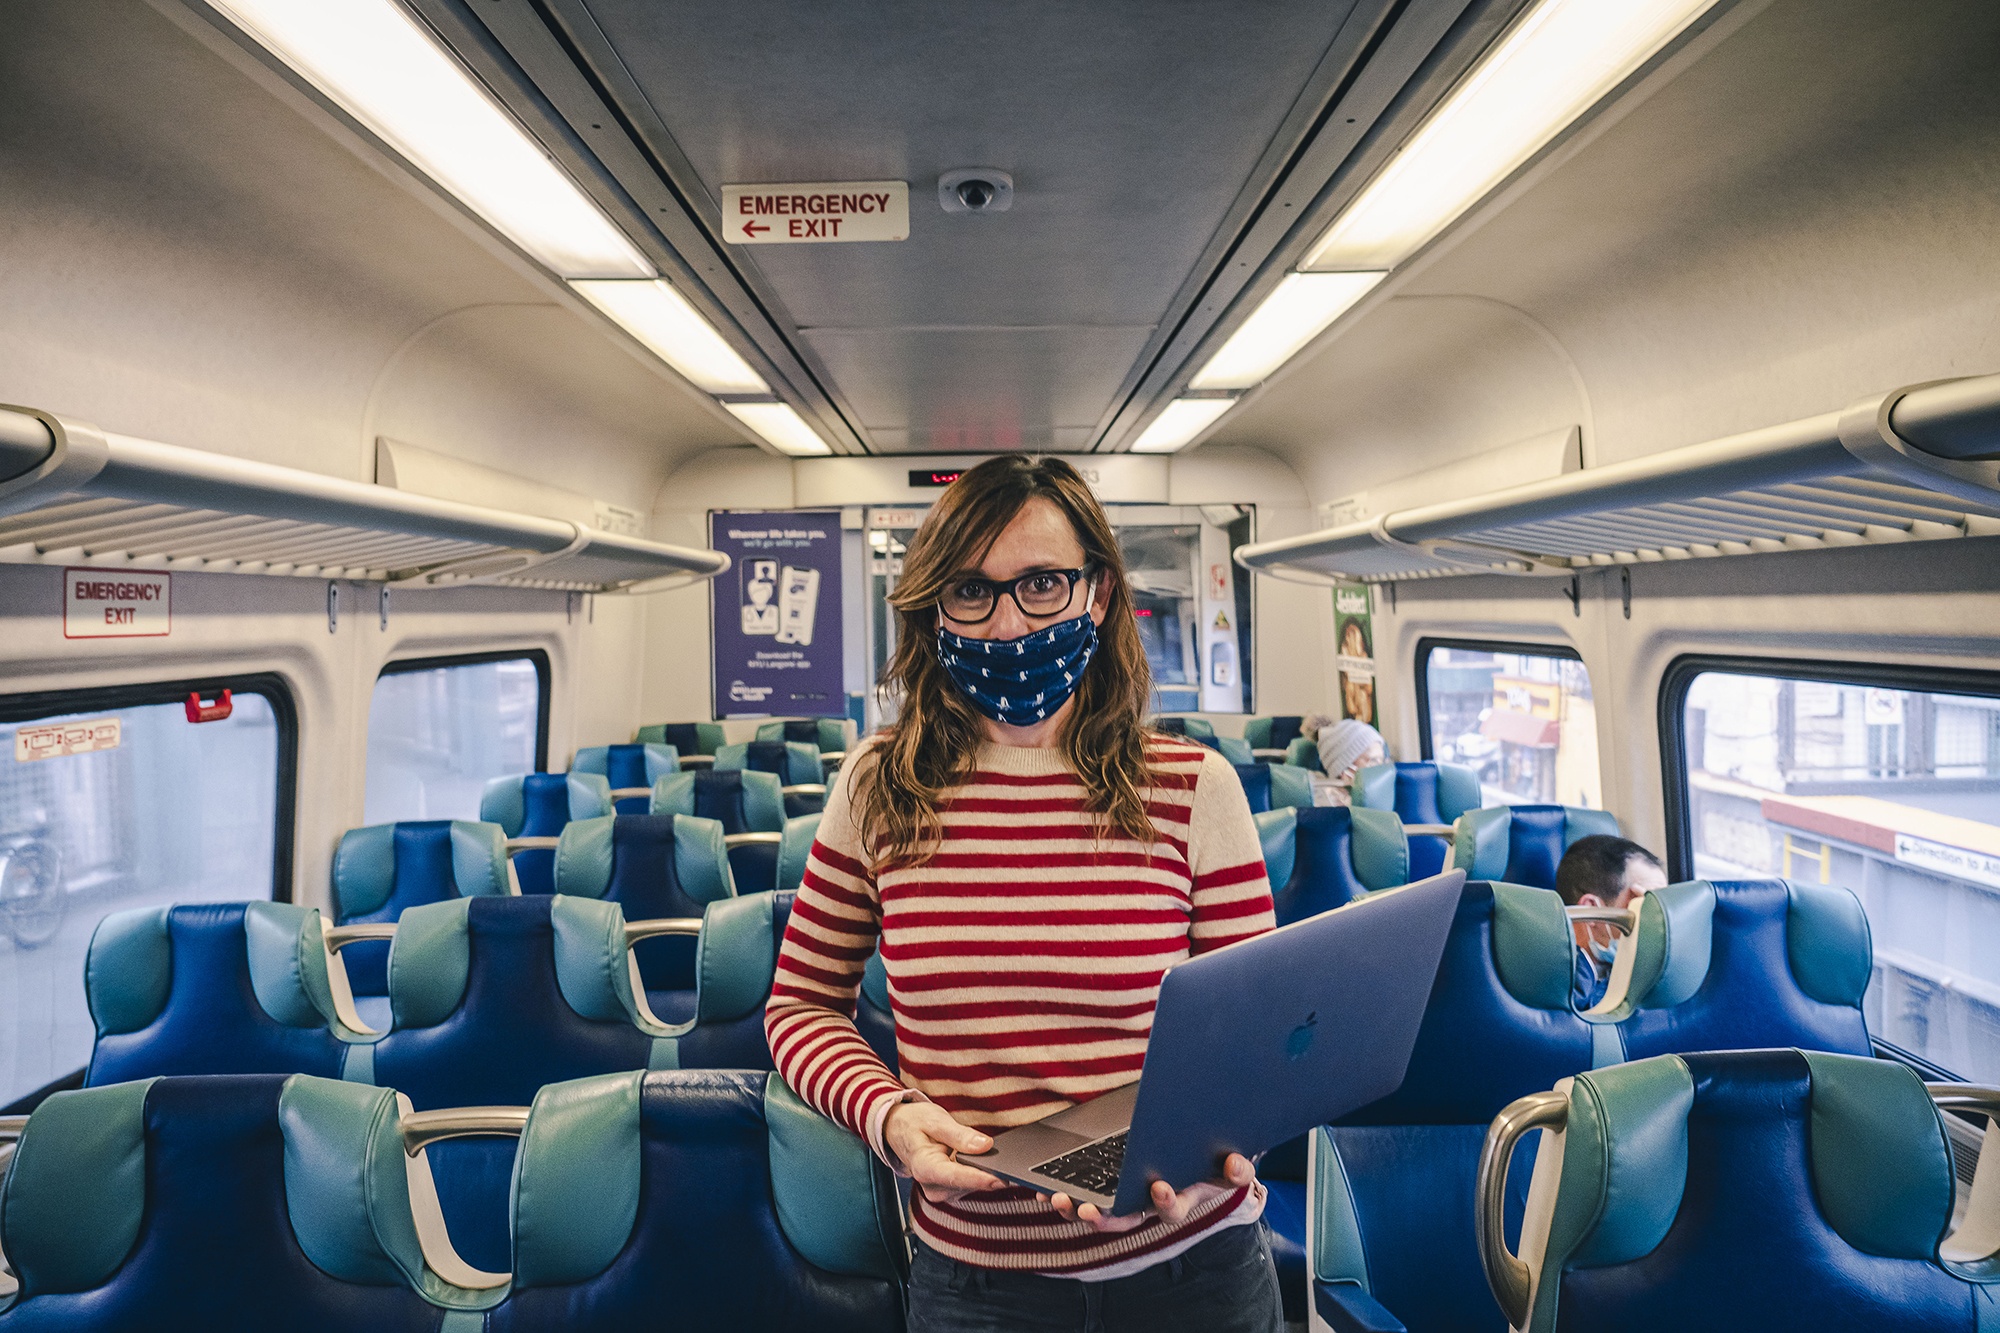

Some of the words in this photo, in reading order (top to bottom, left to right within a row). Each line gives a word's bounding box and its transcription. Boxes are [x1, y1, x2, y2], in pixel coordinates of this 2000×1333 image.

[739, 193, 890, 215] EMERGENCY
[788, 218, 843, 238] EXIT
[75, 581, 162, 601] EMERGENCY
[104, 607, 136, 624] EXIT
[56, 734, 62, 745] 2
